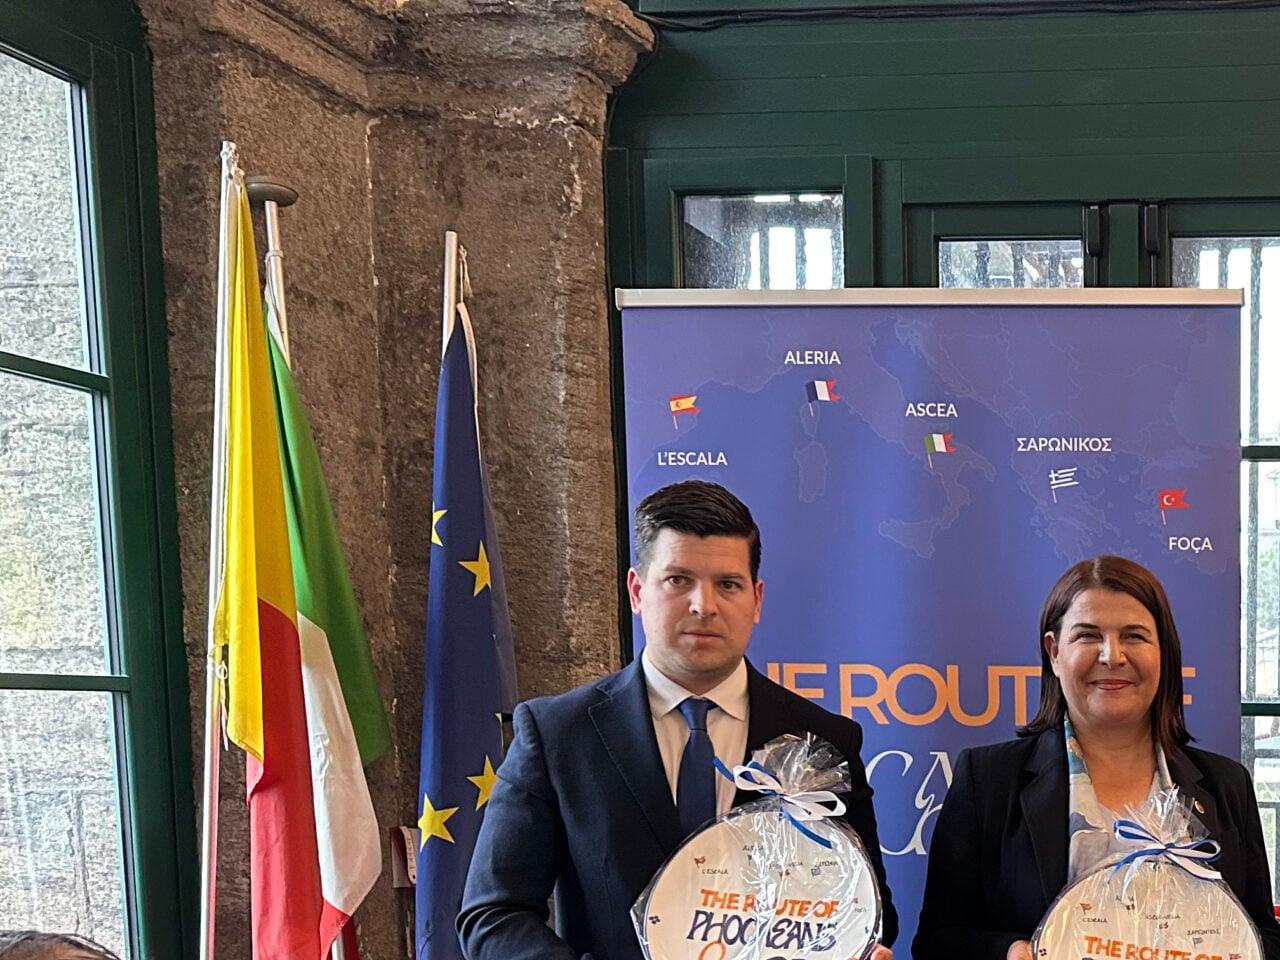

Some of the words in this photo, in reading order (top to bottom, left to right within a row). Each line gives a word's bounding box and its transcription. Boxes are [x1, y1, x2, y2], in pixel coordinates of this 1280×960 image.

[784, 350, 841, 366] ALERIA
[905, 402, 958, 418] ASCEA
[1016, 437, 1112, 453] ΣΑΡΩΝΙΚΟΣ
[1168, 536, 1213, 554] FOÇA
[839, 663, 1043, 727] ROUT
[700, 888, 740, 910] THE
[1084, 935, 1123, 958] THE
